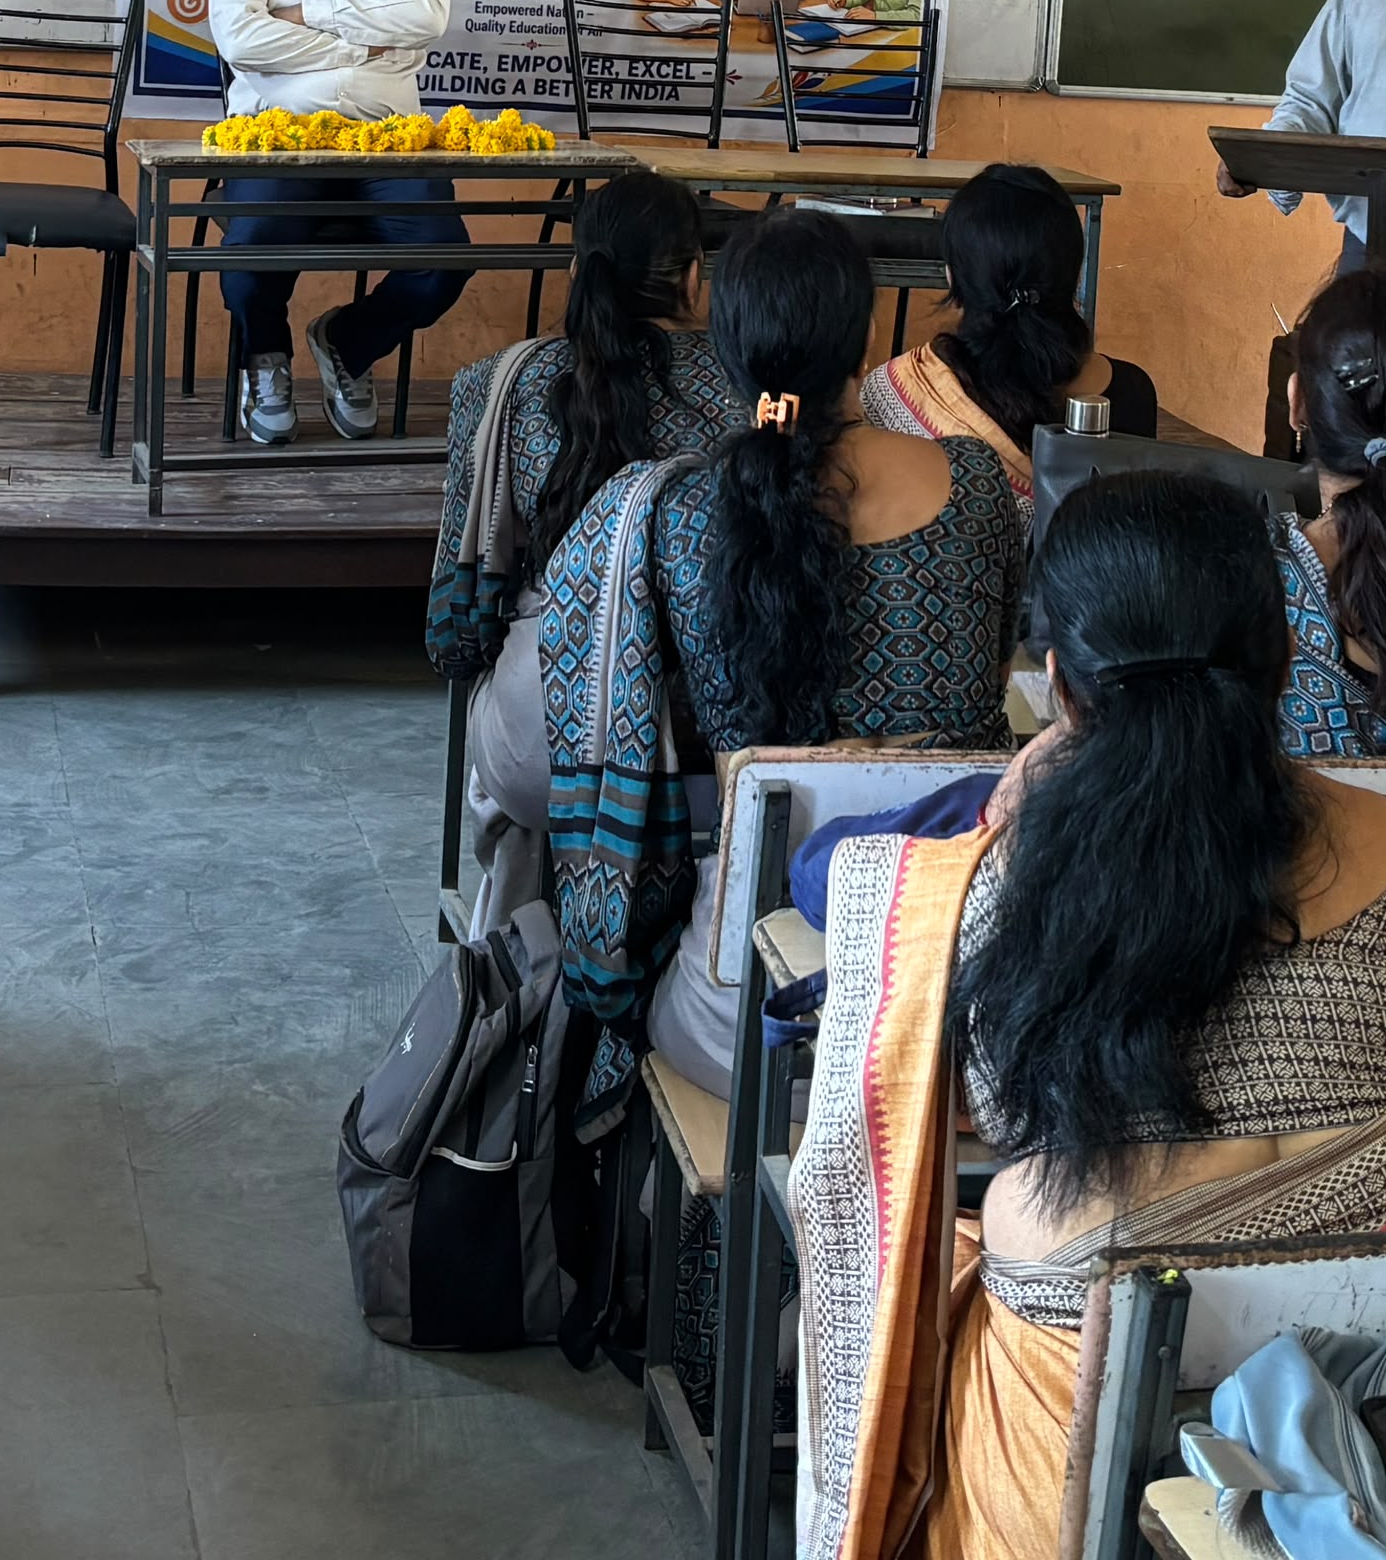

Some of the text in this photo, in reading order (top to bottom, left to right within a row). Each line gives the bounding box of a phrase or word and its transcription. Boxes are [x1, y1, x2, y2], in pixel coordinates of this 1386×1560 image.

[475, 1, 543, 17] Empowered
[546, 4, 584, 19] Natn
[465, 18, 506, 35] Quality
[509, 20, 566, 35] Education
[426, 50, 488, 75] CATE,
[497, 54, 620, 79] EMPOER,
[627, 60, 696, 80] EXCEL
[416, 74, 680, 102] UILDING A BETER INDIA
